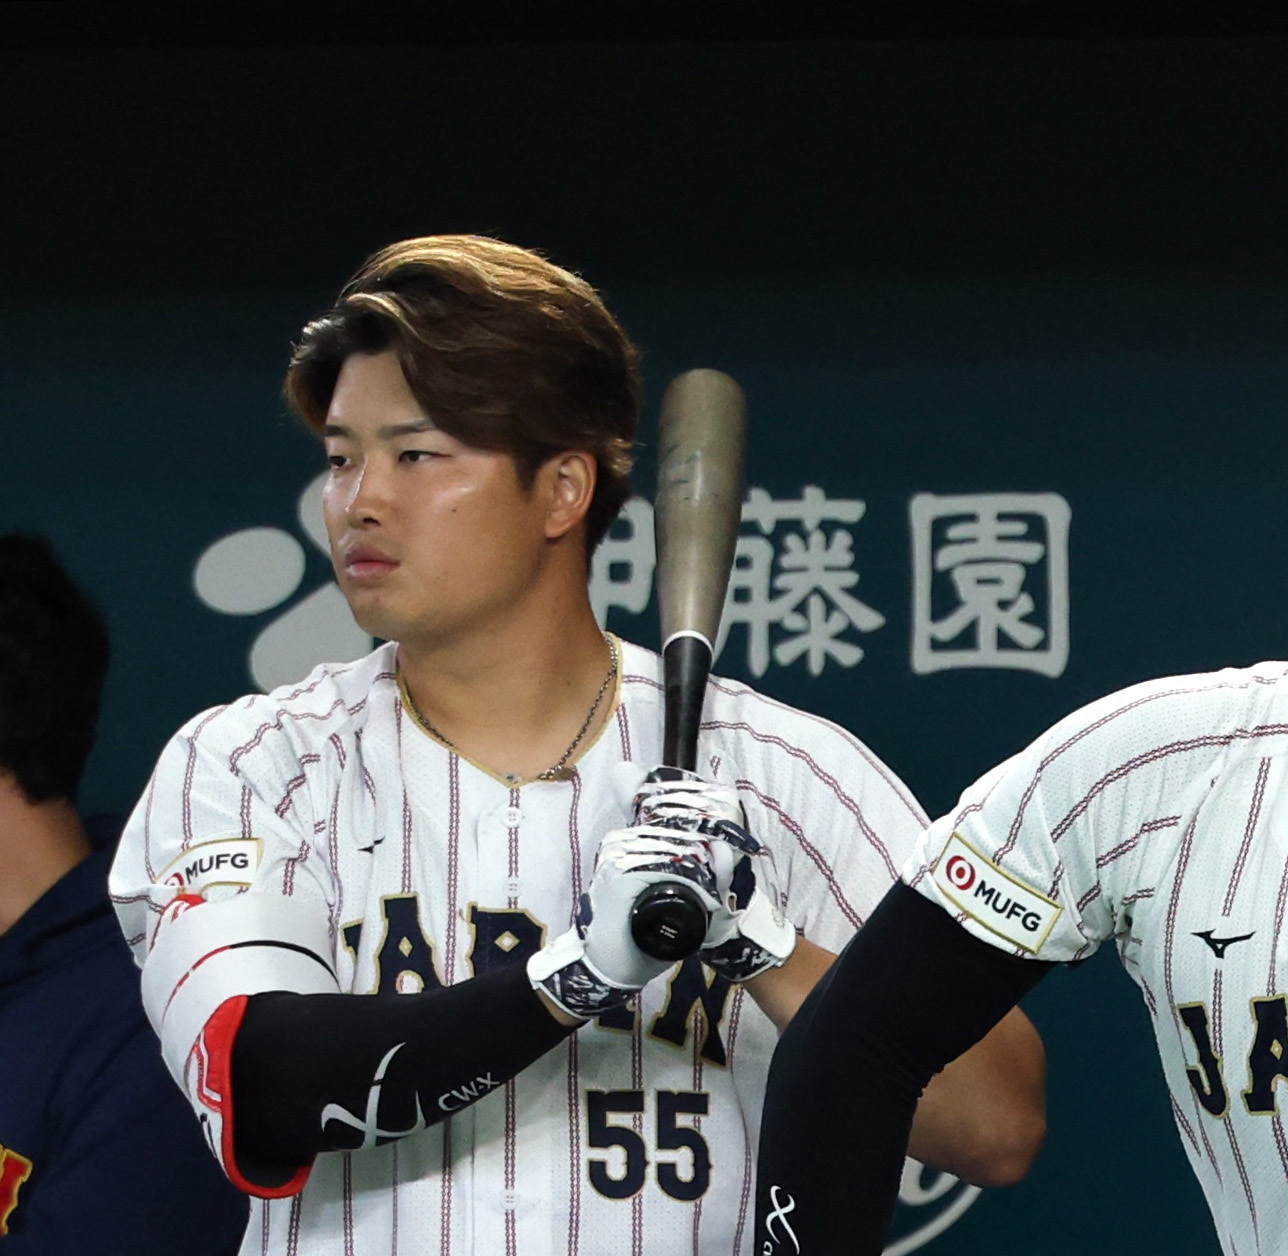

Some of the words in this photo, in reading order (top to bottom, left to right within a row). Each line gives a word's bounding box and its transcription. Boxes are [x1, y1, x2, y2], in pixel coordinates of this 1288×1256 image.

[185, 852, 249, 885] MUFG
[974, 879, 1043, 932] MUFG
[438, 1071, 501, 1112] CW-X
[585, 1087, 713, 1203] 55
